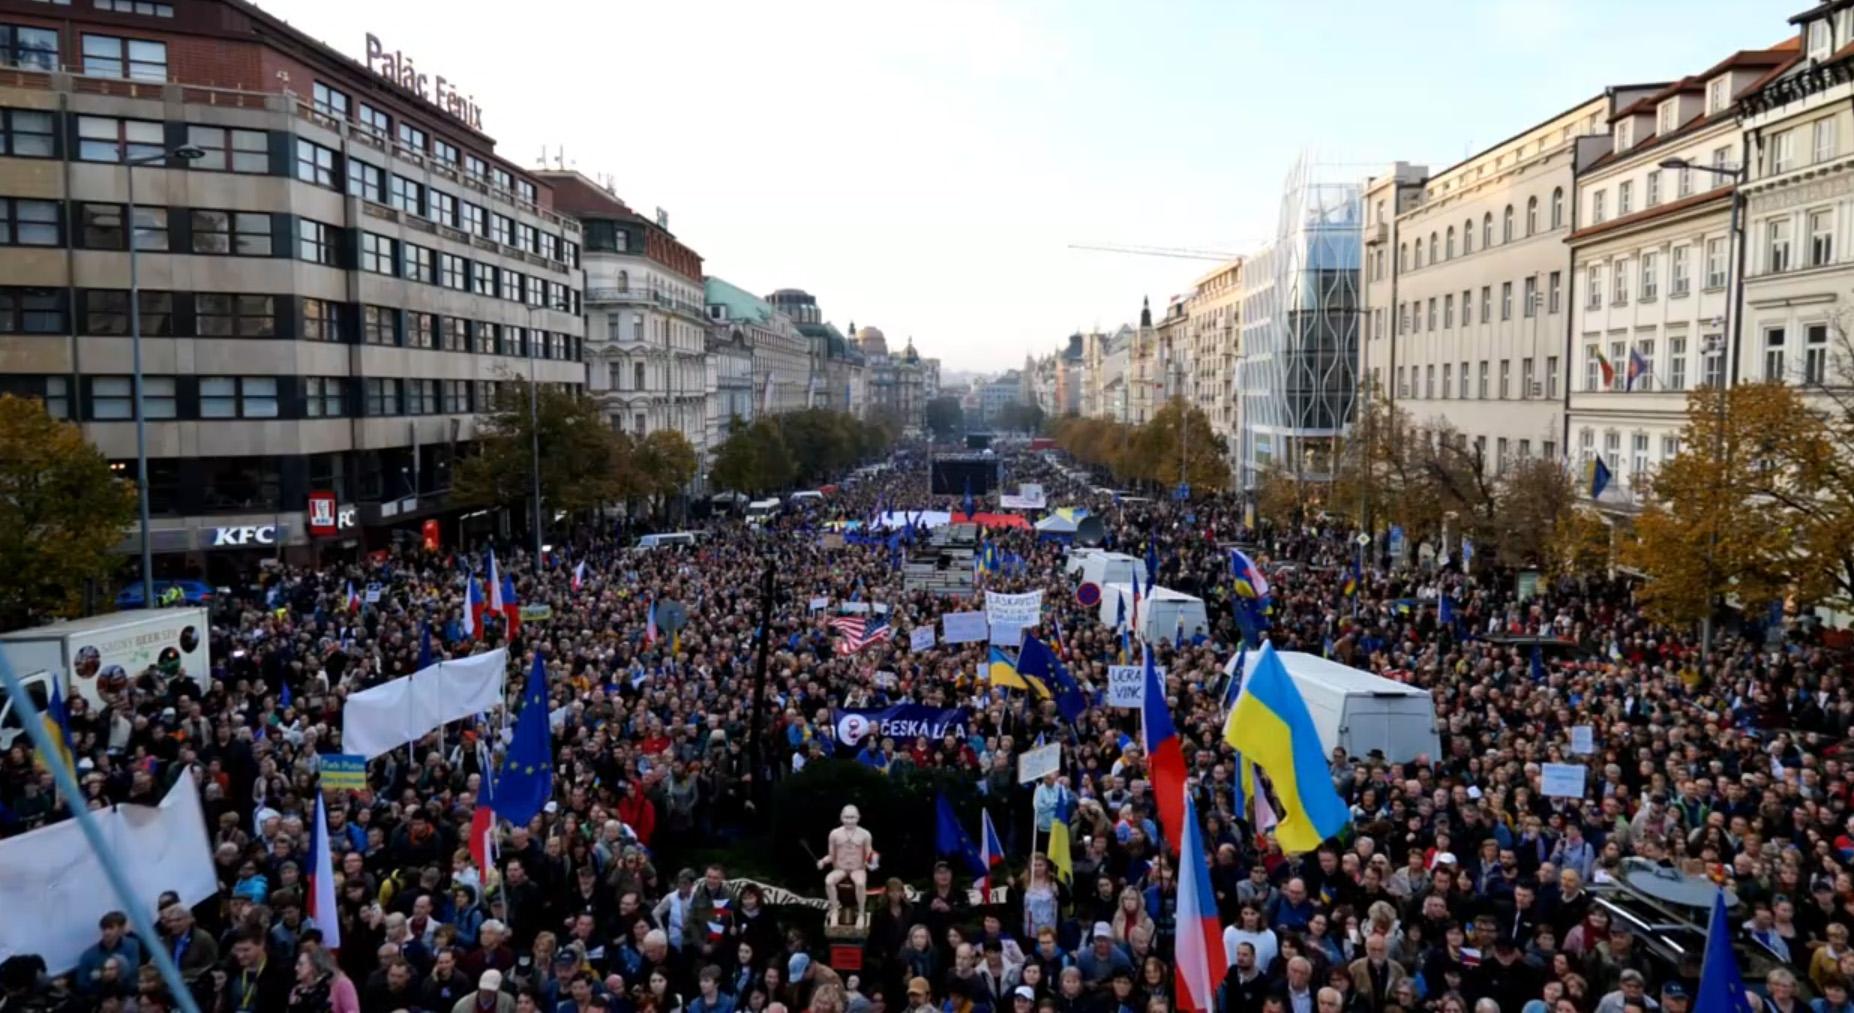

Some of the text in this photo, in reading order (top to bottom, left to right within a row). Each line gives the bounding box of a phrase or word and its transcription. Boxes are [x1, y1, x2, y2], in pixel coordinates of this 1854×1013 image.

[338, 510, 355, 528] FC
[213, 526, 275, 545] KFC
[1114, 685, 1142, 699] VINC
[880, 718, 966, 739] ČESKÁ LÍA
